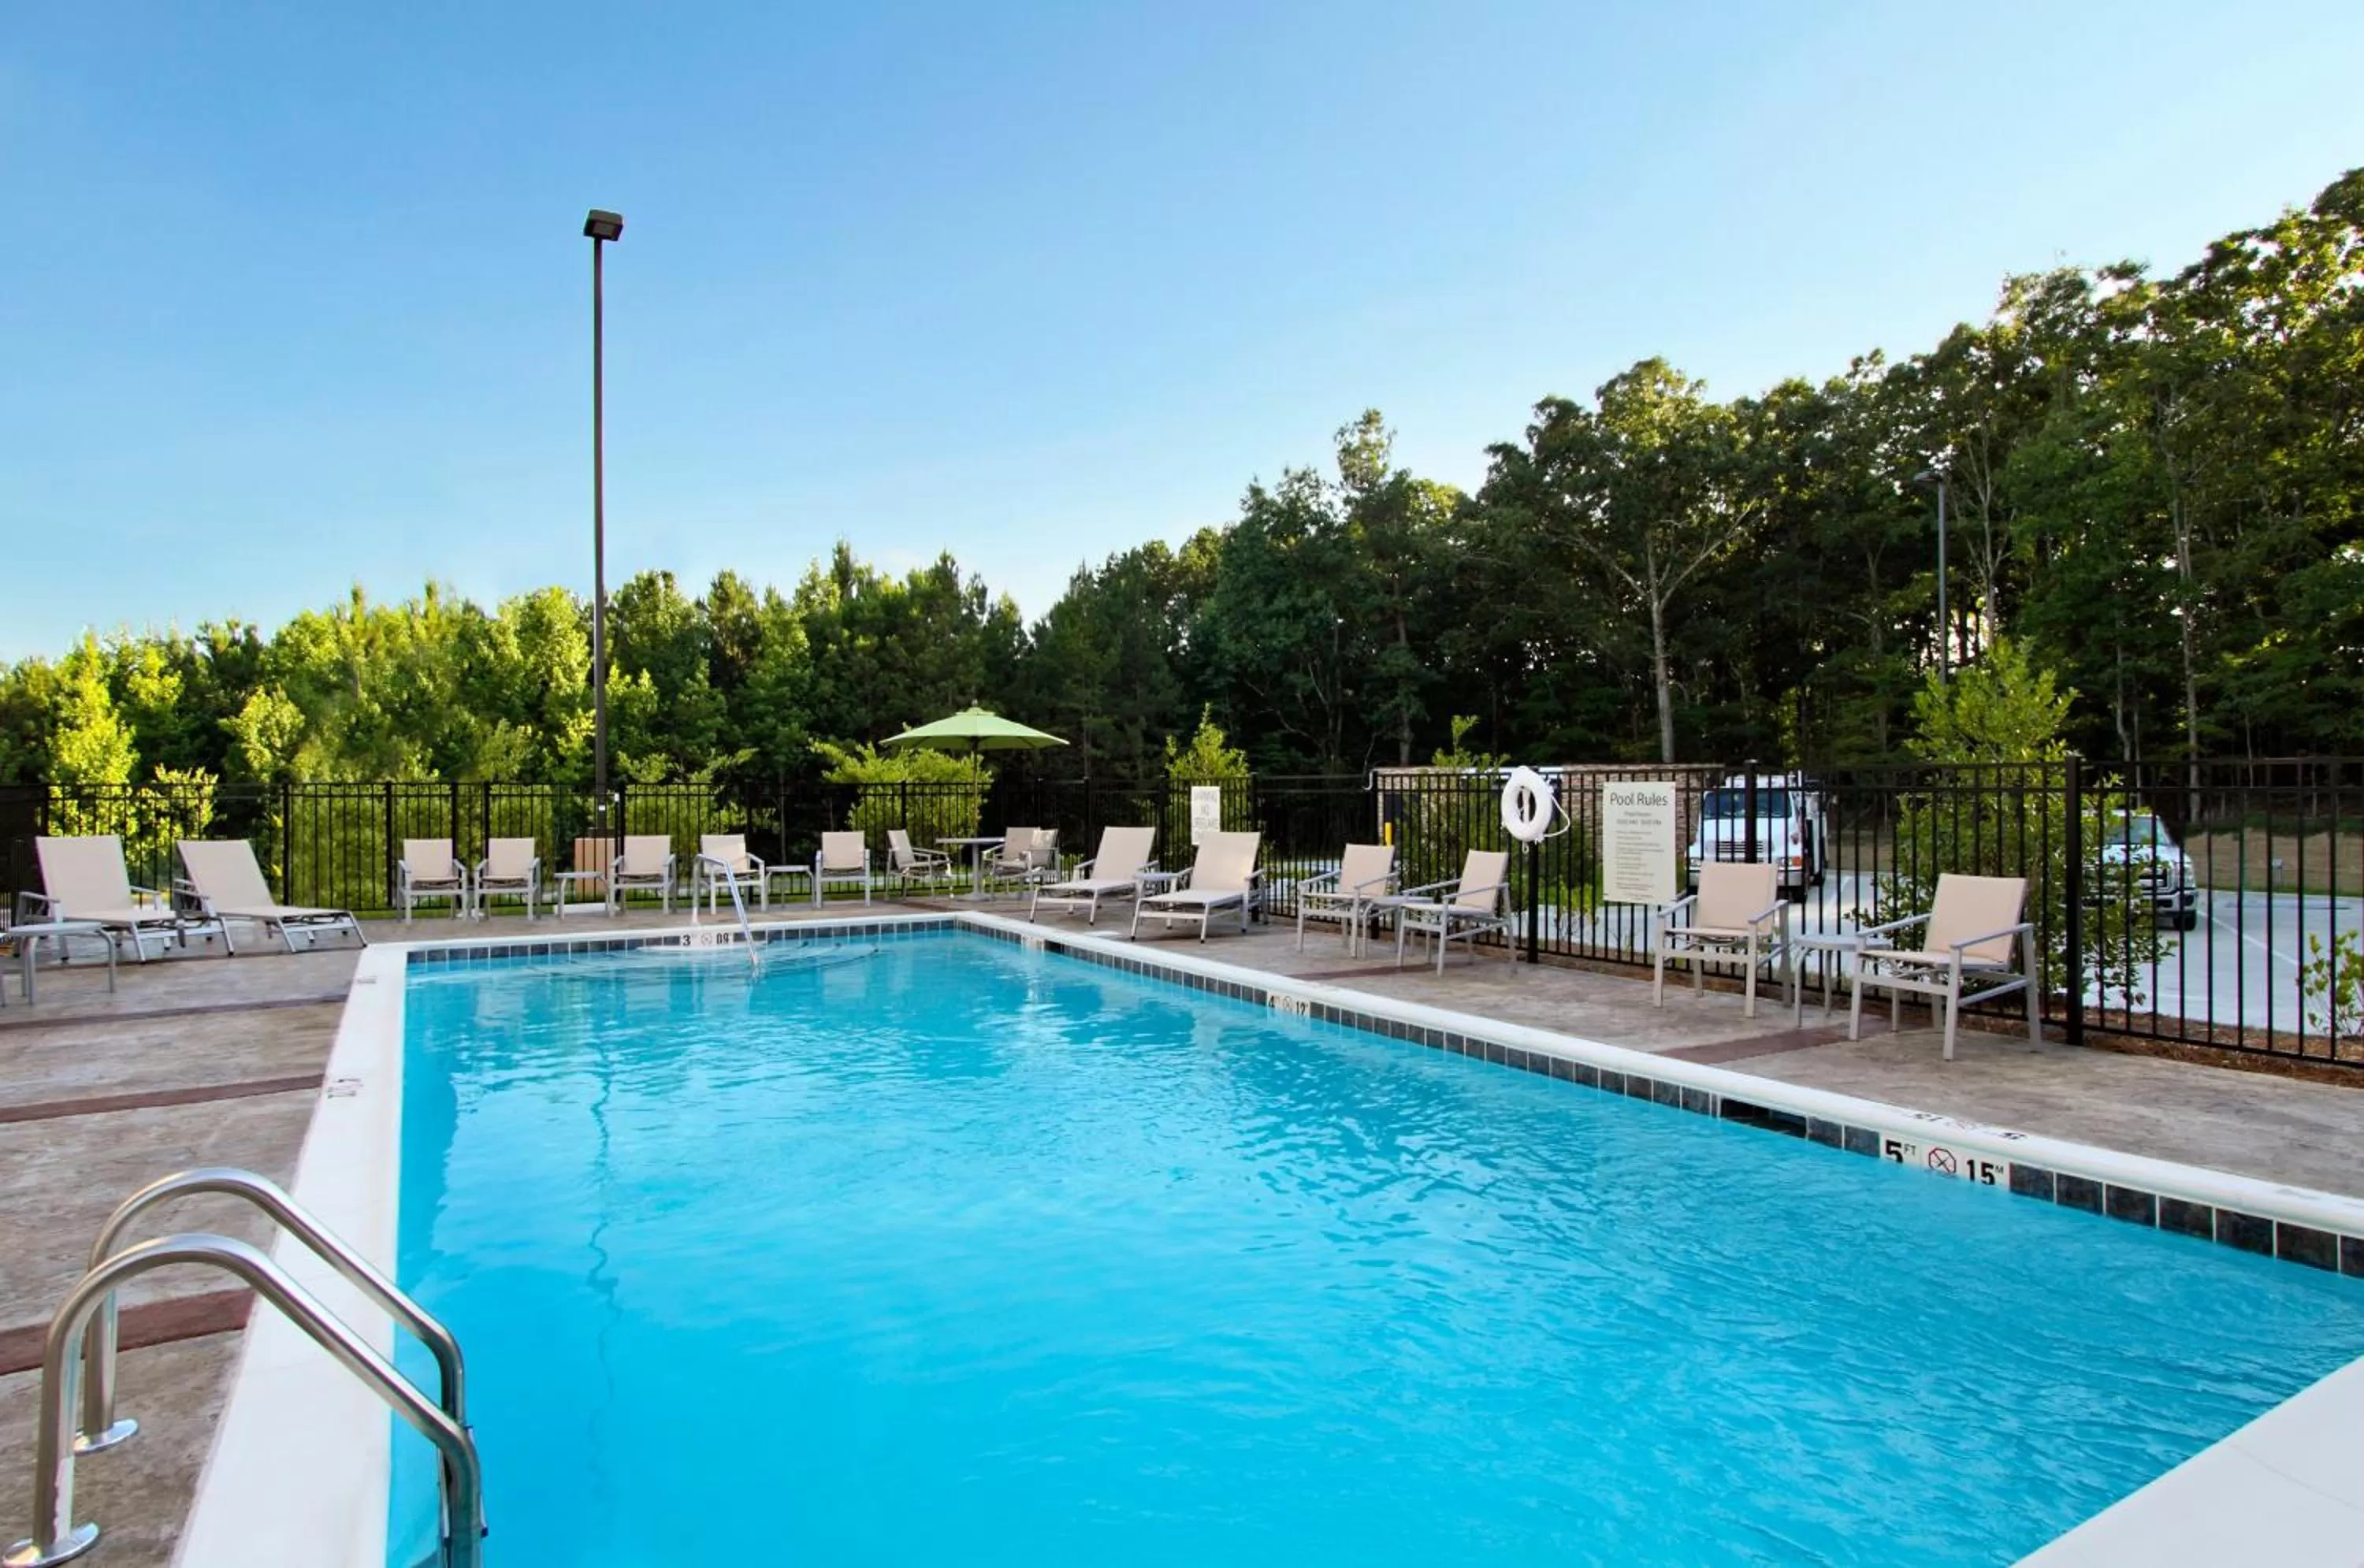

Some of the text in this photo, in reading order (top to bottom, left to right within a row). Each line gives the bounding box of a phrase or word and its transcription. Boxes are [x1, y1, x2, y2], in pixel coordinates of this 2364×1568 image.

[1610, 792, 1668, 806] Pool Rules
[682, 934, 691, 946] 3
